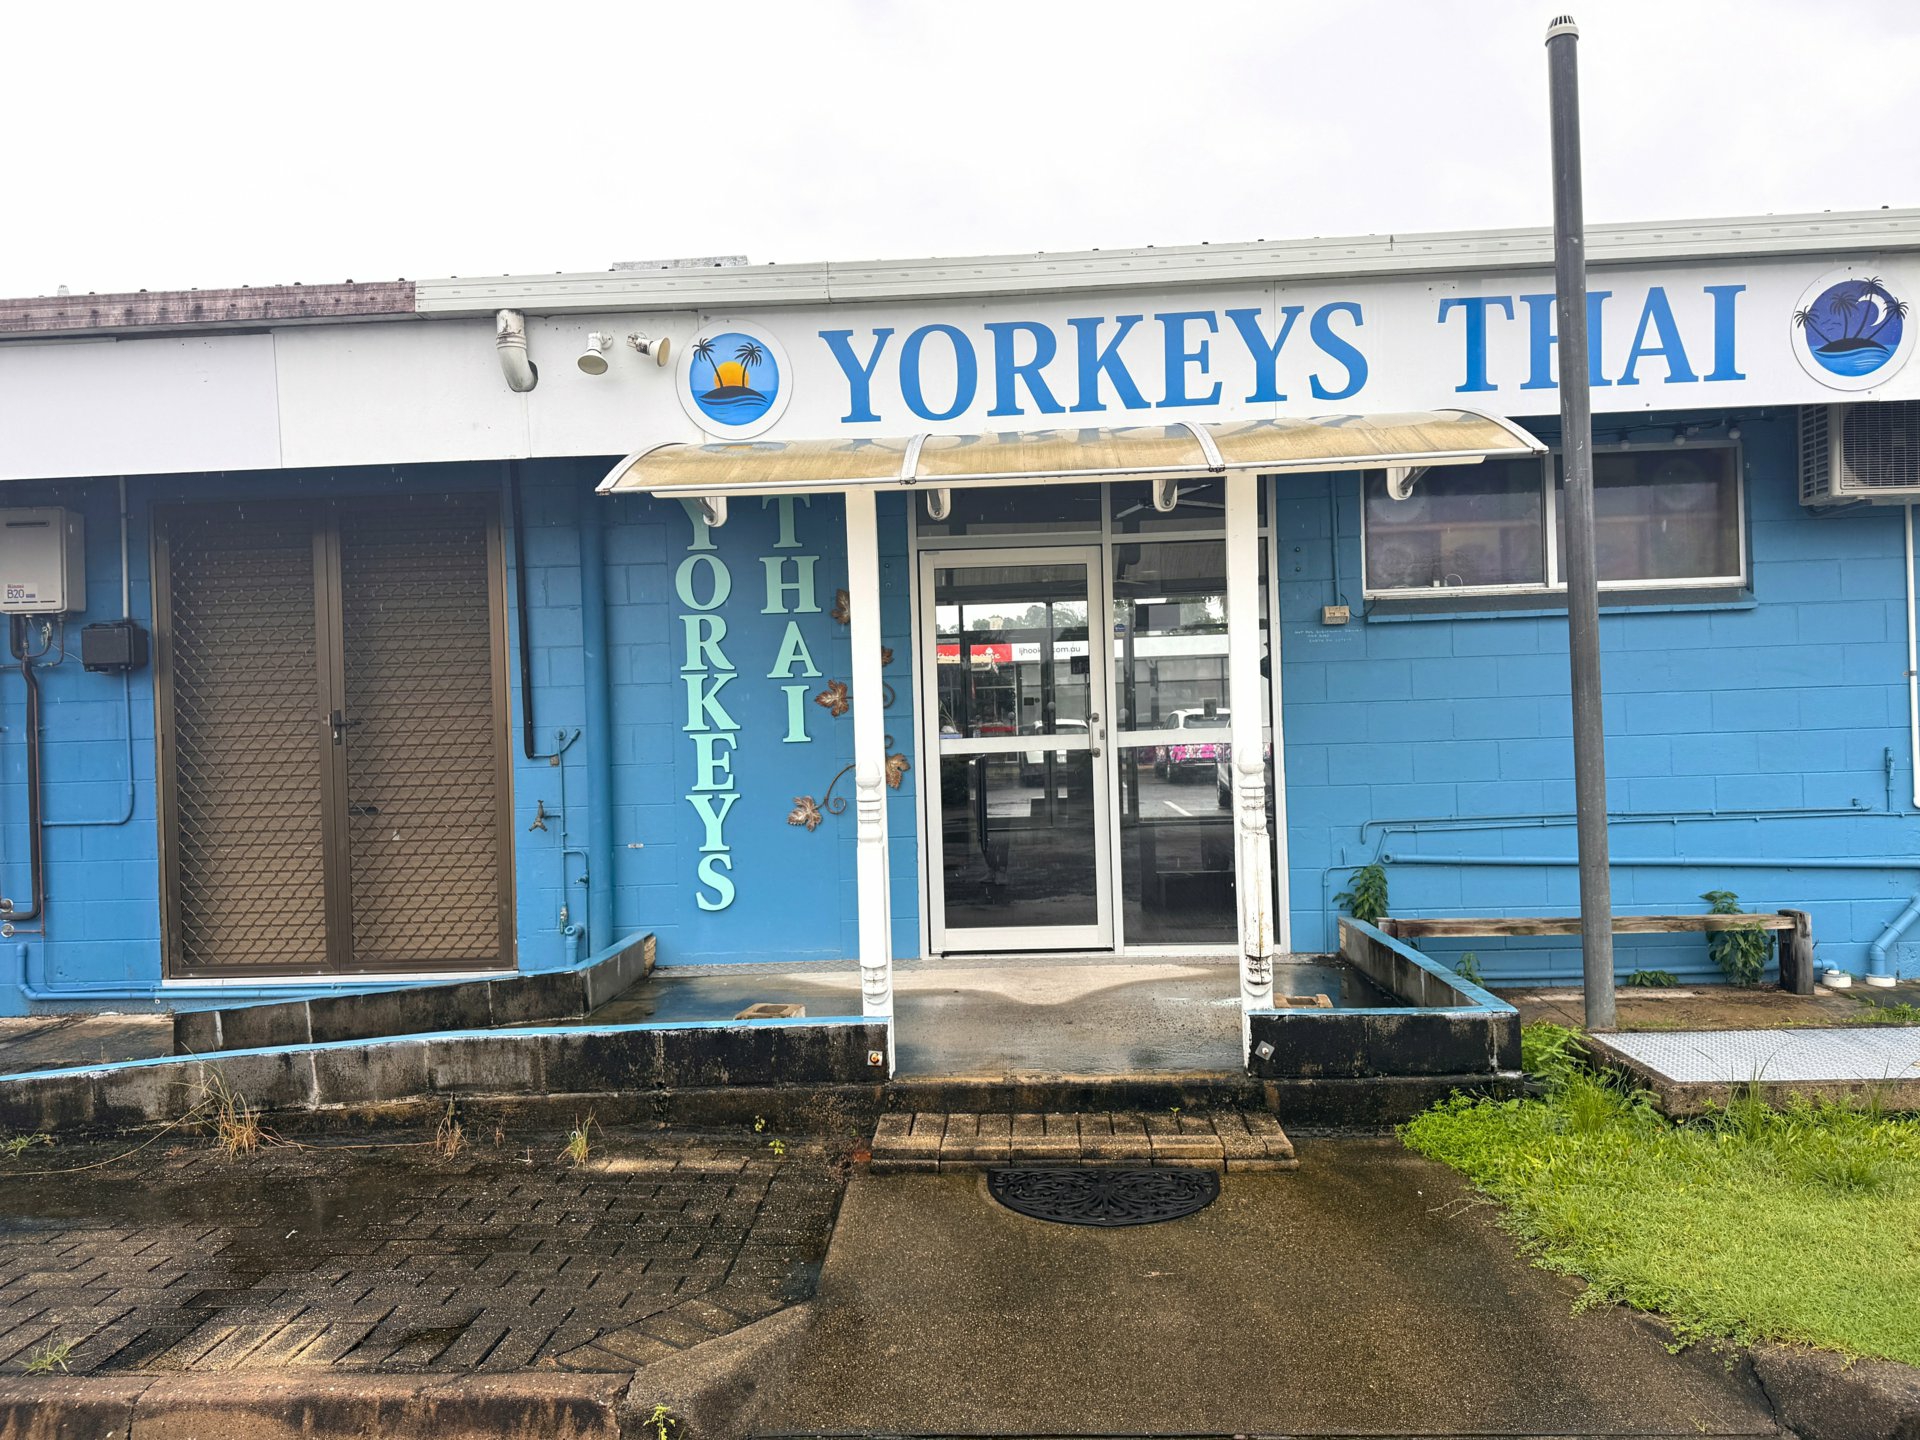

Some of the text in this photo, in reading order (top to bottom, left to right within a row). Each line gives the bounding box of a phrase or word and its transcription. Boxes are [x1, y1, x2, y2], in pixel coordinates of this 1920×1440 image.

[818, 285, 1746, 424] YORKEYS THAI
[7, 589, 25, 599] B20
[760, 493, 823, 744] THAI
[675, 496, 740, 912] YORKEYS
